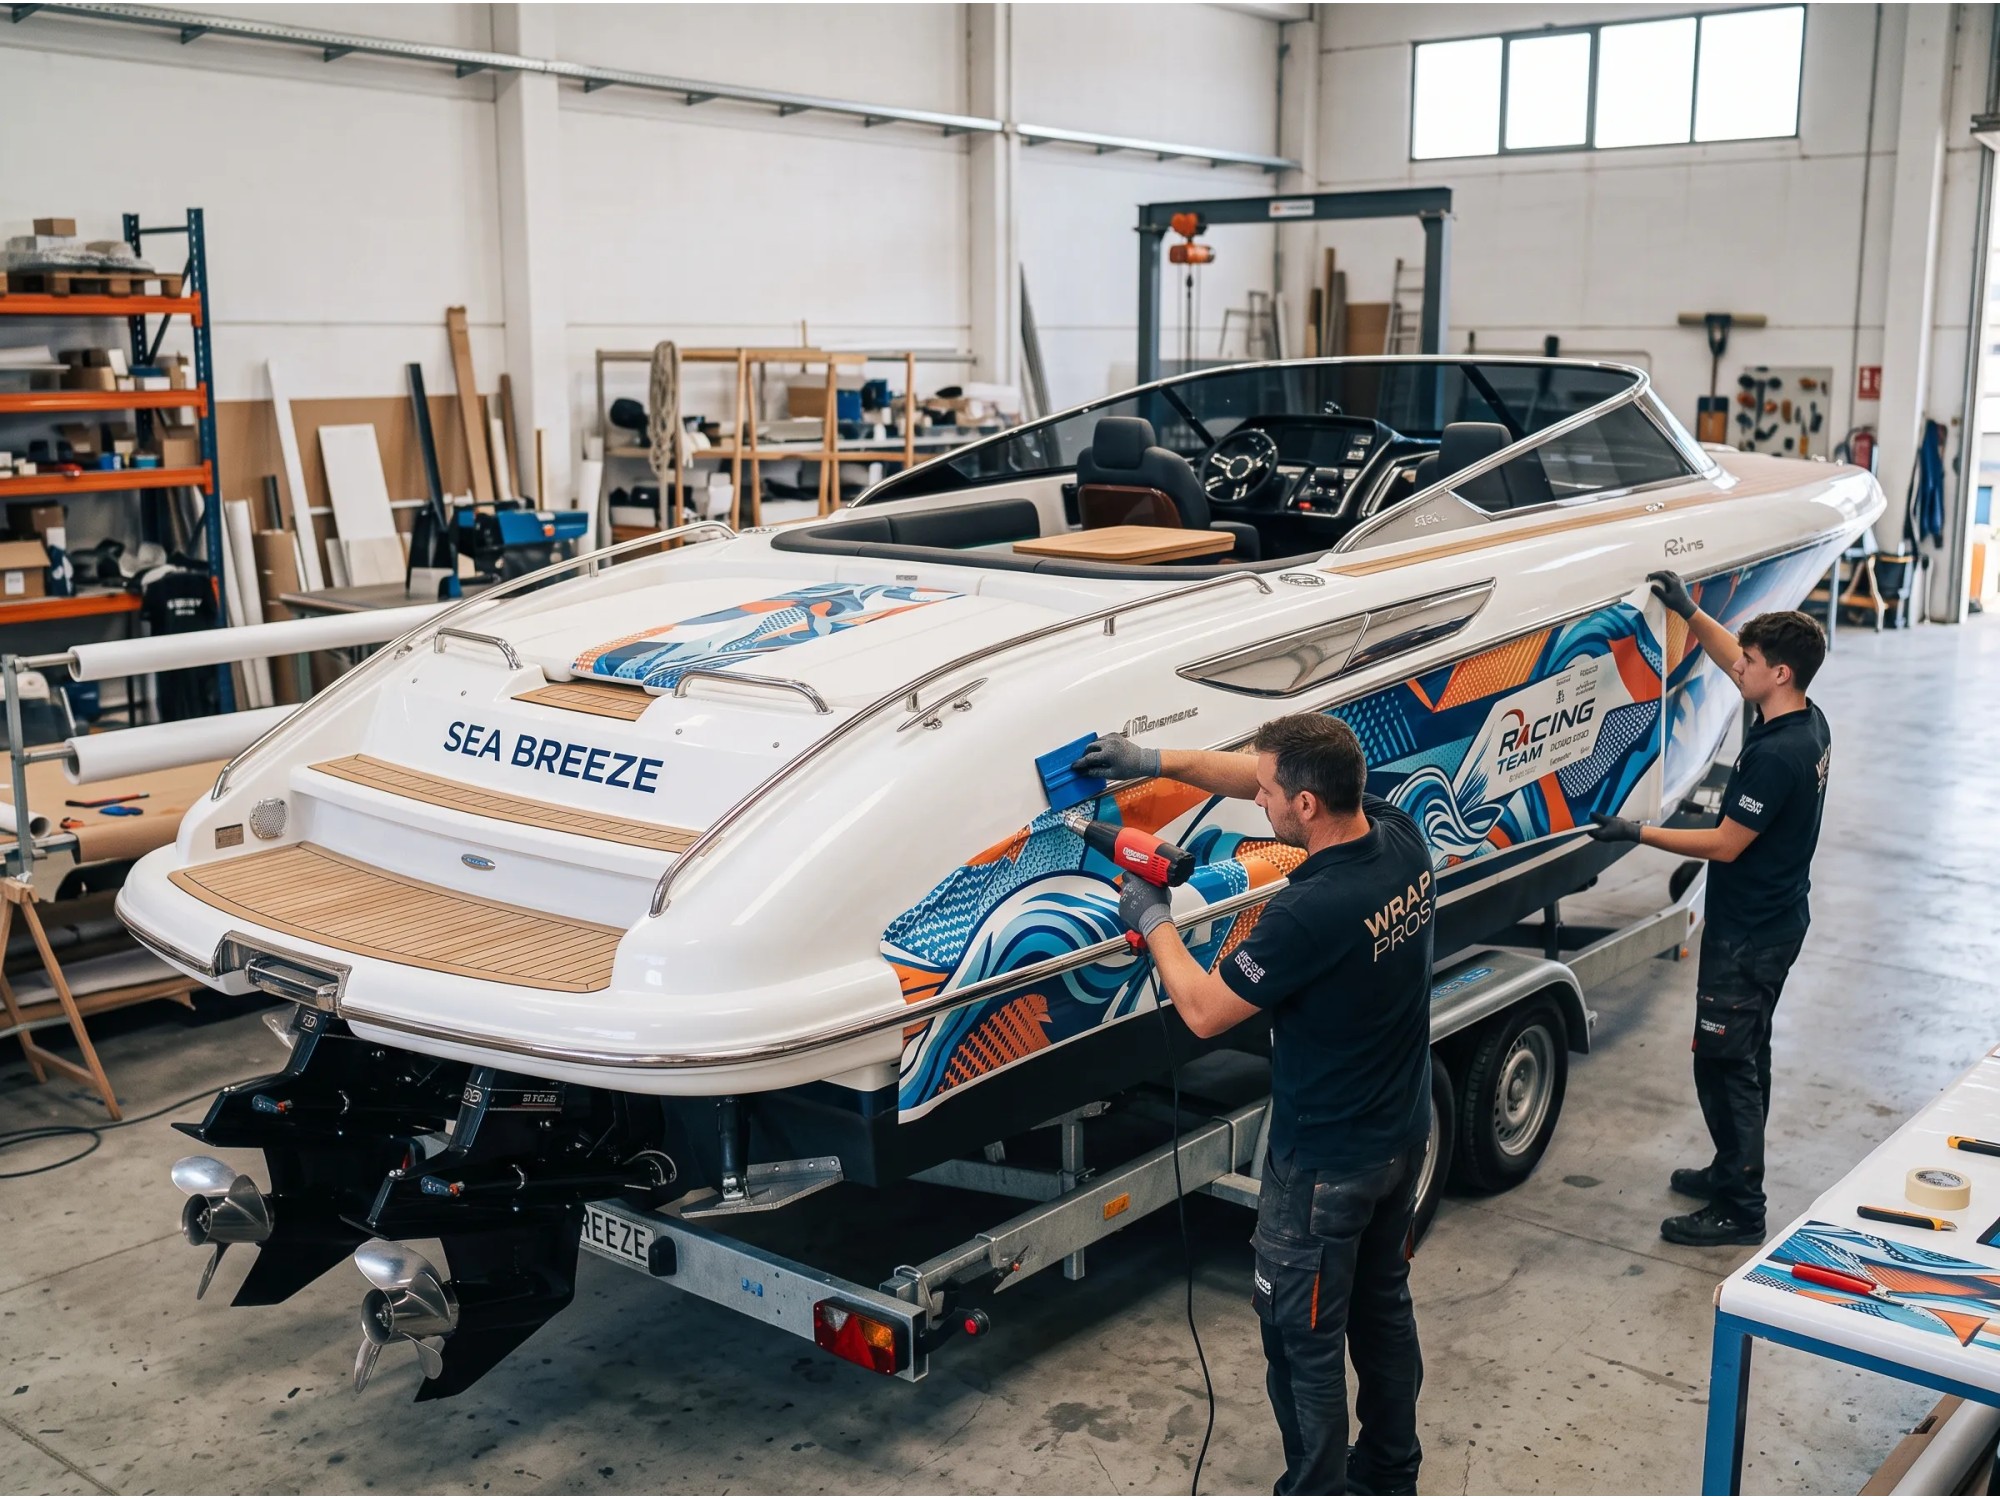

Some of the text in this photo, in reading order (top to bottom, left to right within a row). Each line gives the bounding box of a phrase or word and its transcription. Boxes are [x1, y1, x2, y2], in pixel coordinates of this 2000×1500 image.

[443, 721, 664, 793] SEA BREEZE
[1498, 698, 1596, 757] RACING
[1497, 743, 1543, 775] TEAM
[1364, 870, 1431, 938] WRAP
[1374, 900, 1431, 962] PROS
